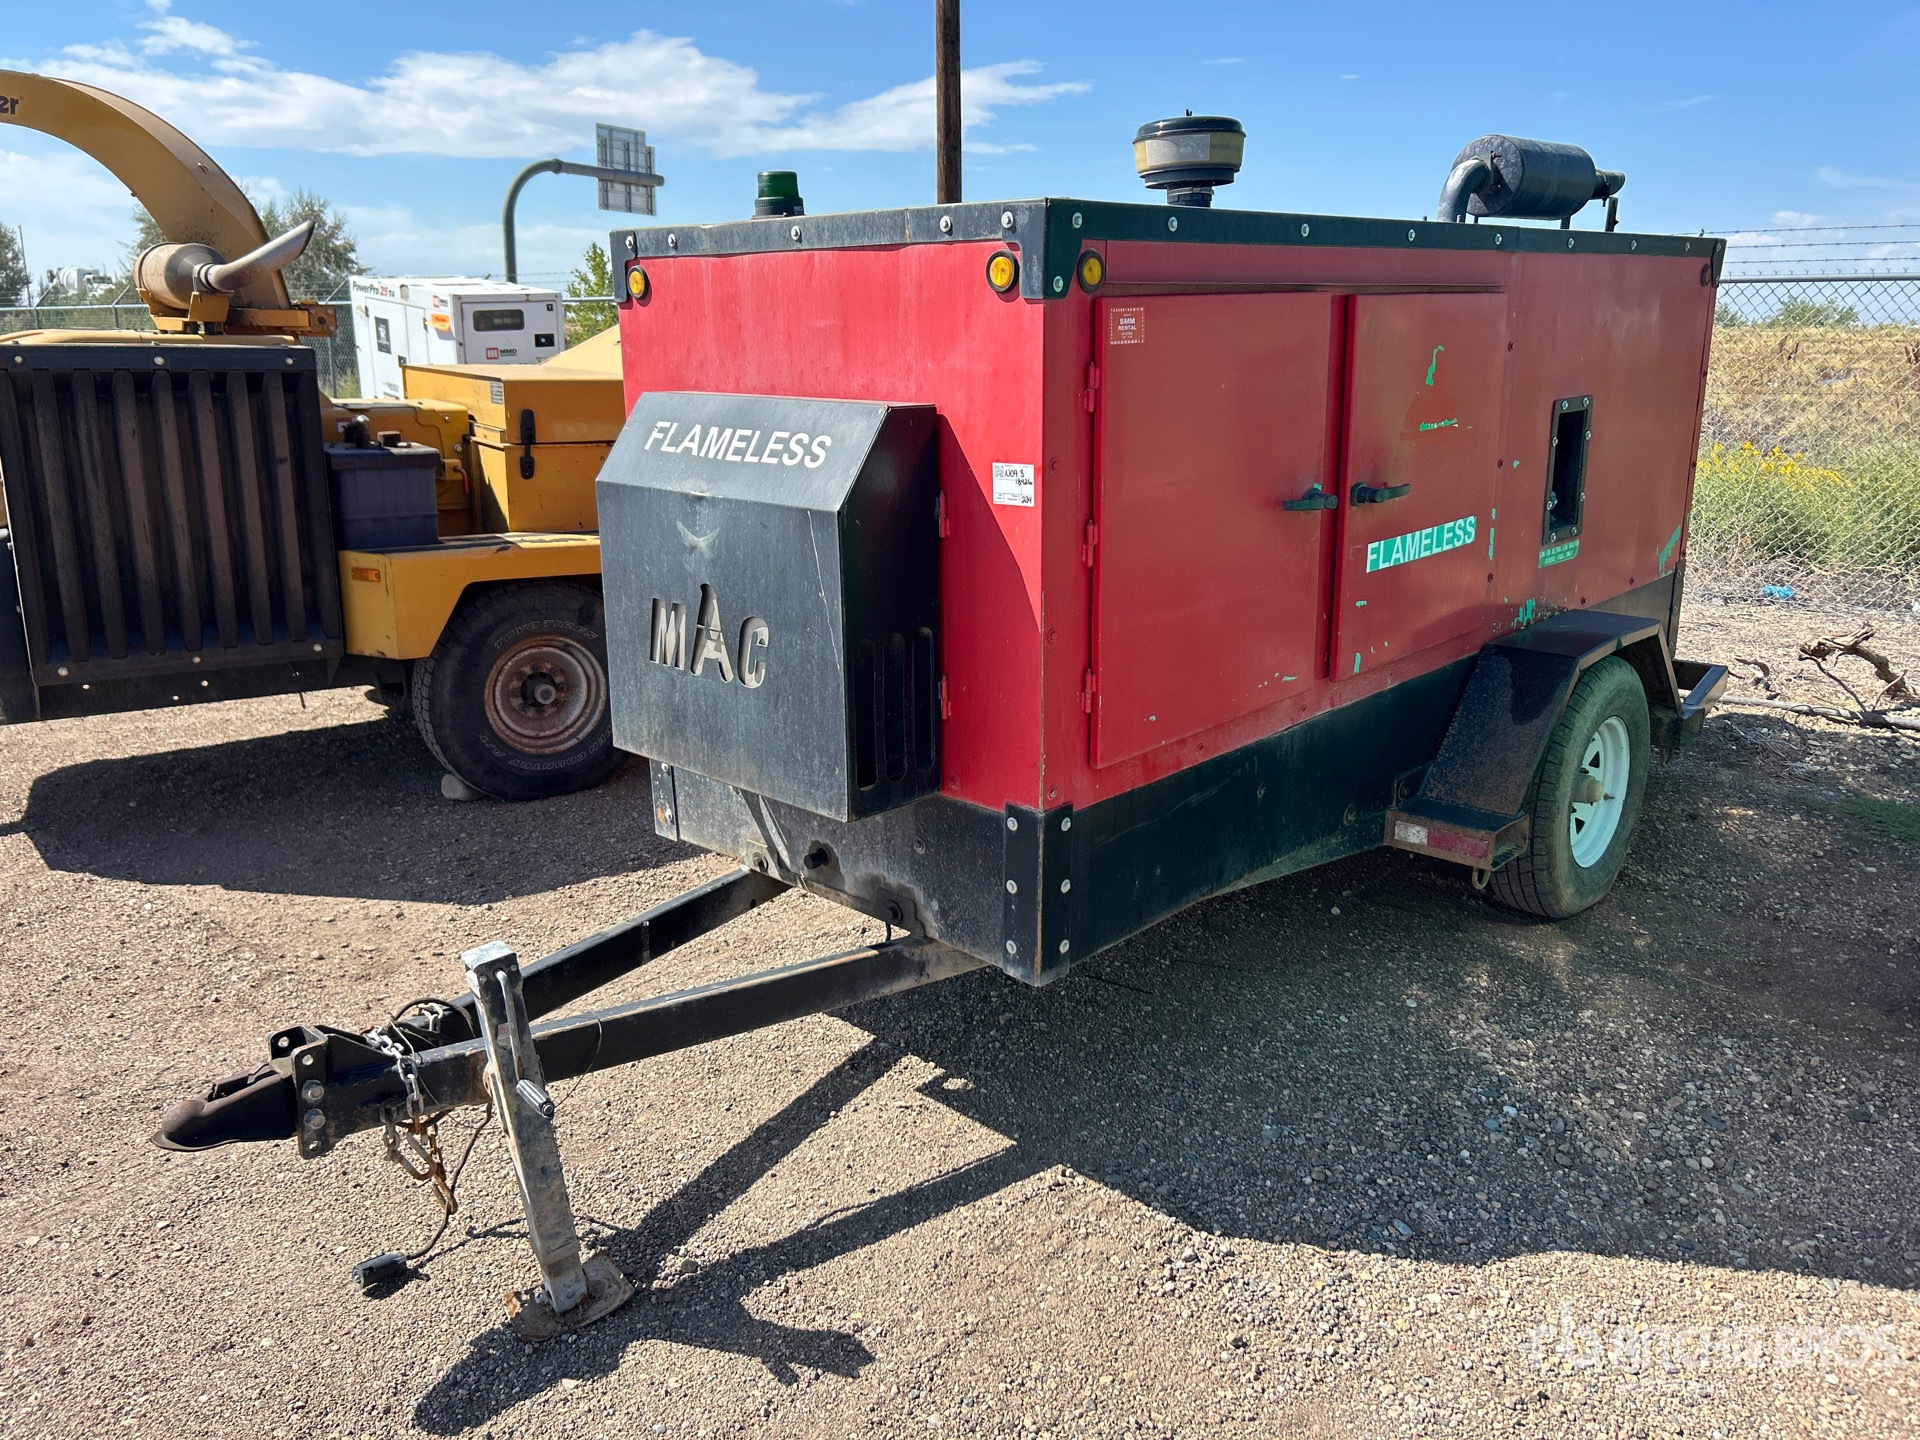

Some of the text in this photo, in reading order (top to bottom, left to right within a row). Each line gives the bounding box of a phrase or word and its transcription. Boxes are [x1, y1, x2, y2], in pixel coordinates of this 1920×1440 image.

[380, 286, 388, 296] 25
[644, 421, 832, 469] FLAMELESS
[1366, 515, 1477, 573] FLAMELESS
[494, 619, 599, 649] TOYO TIRES
[650, 583, 769, 688] MAC
[588, 724, 613, 754] PEN
[509, 752, 587, 770] COUNTRY
